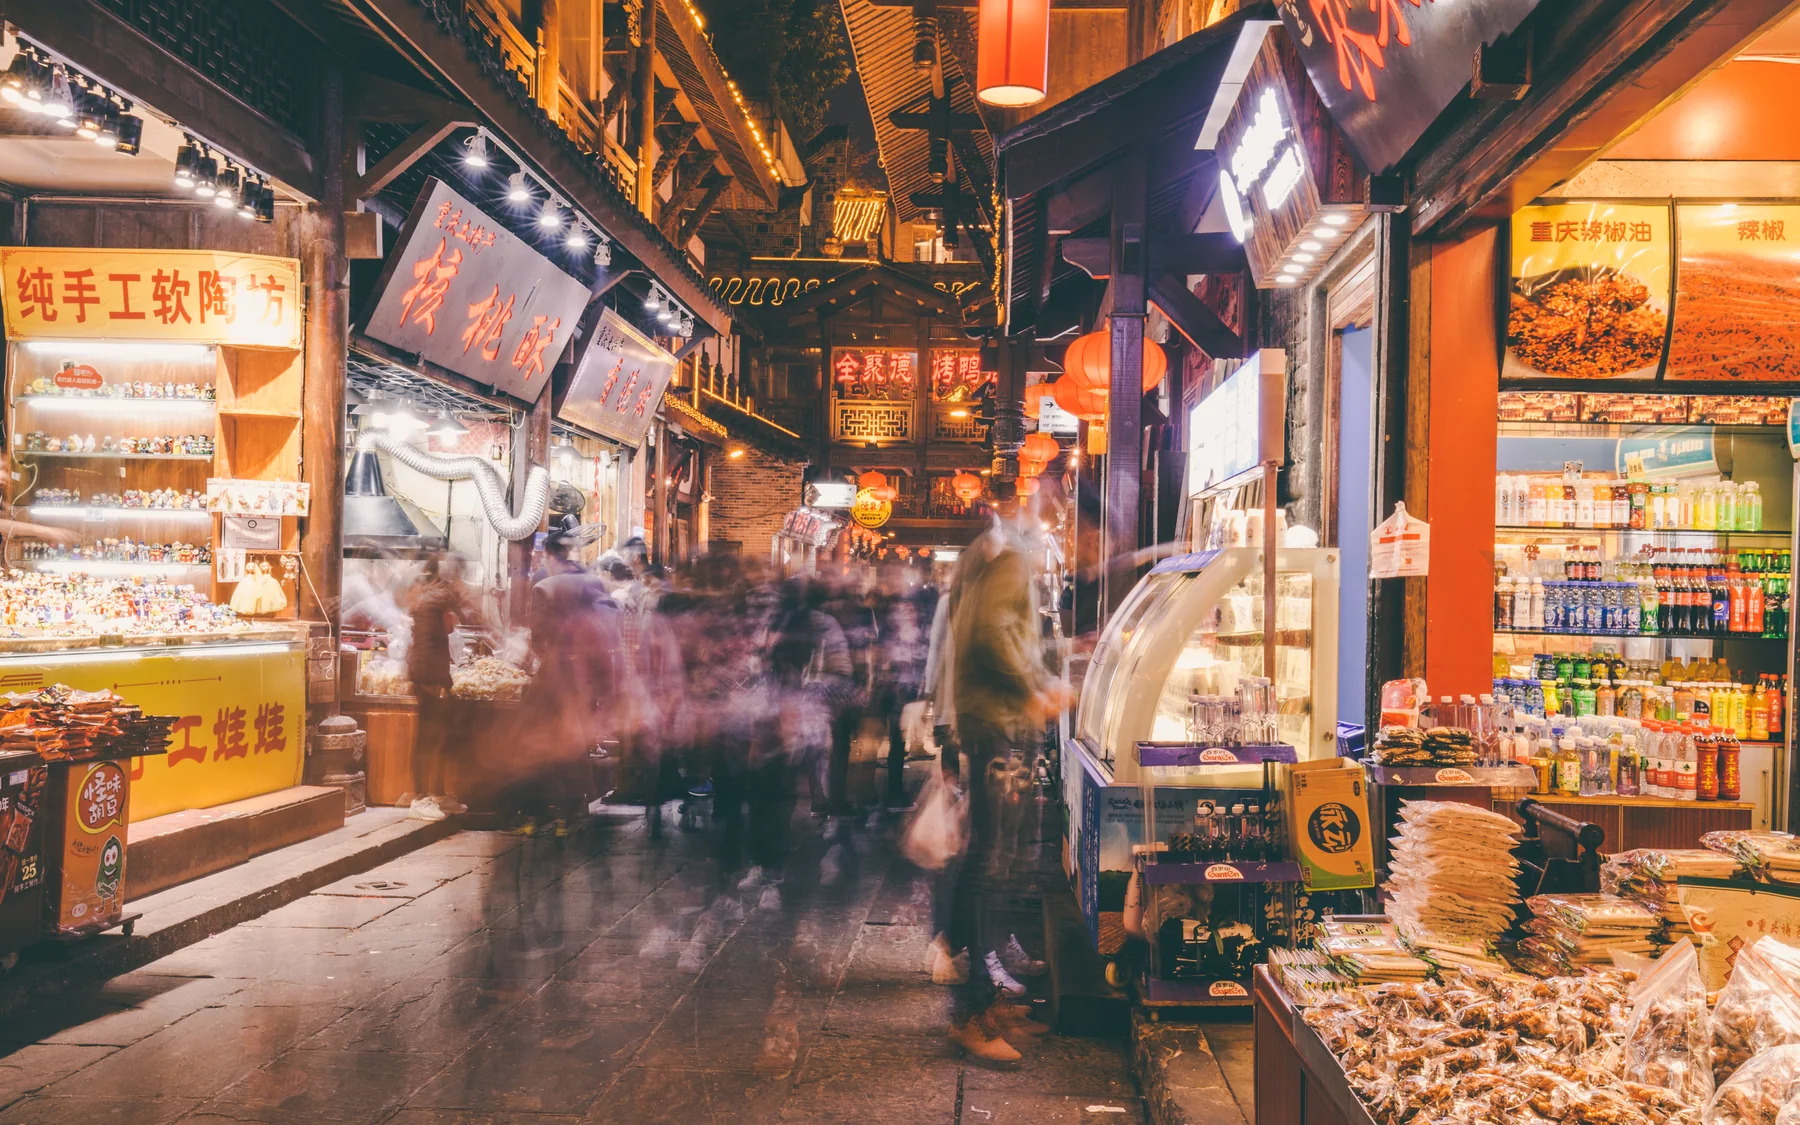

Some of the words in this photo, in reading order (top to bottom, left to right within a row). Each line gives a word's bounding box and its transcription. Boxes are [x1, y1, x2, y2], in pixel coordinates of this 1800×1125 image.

[1529, 219, 1652, 243] 重庆辣椒油
[1737, 219, 1786, 241] 辣椒
[16, 266, 286, 328] 纯手工软陶坊
[836, 353, 913, 383] 全聚德
[932, 354, 998, 385] 烤鸭
[130, 701, 288, 781] 工娃娃
[84, 771, 121, 801] 怪味
[1703, 754, 1714, 790] 王老吉
[1725, 754, 1737, 790] 王老吉
[88, 796, 118, 824] 胡豆
[22, 863, 37, 880] 25
